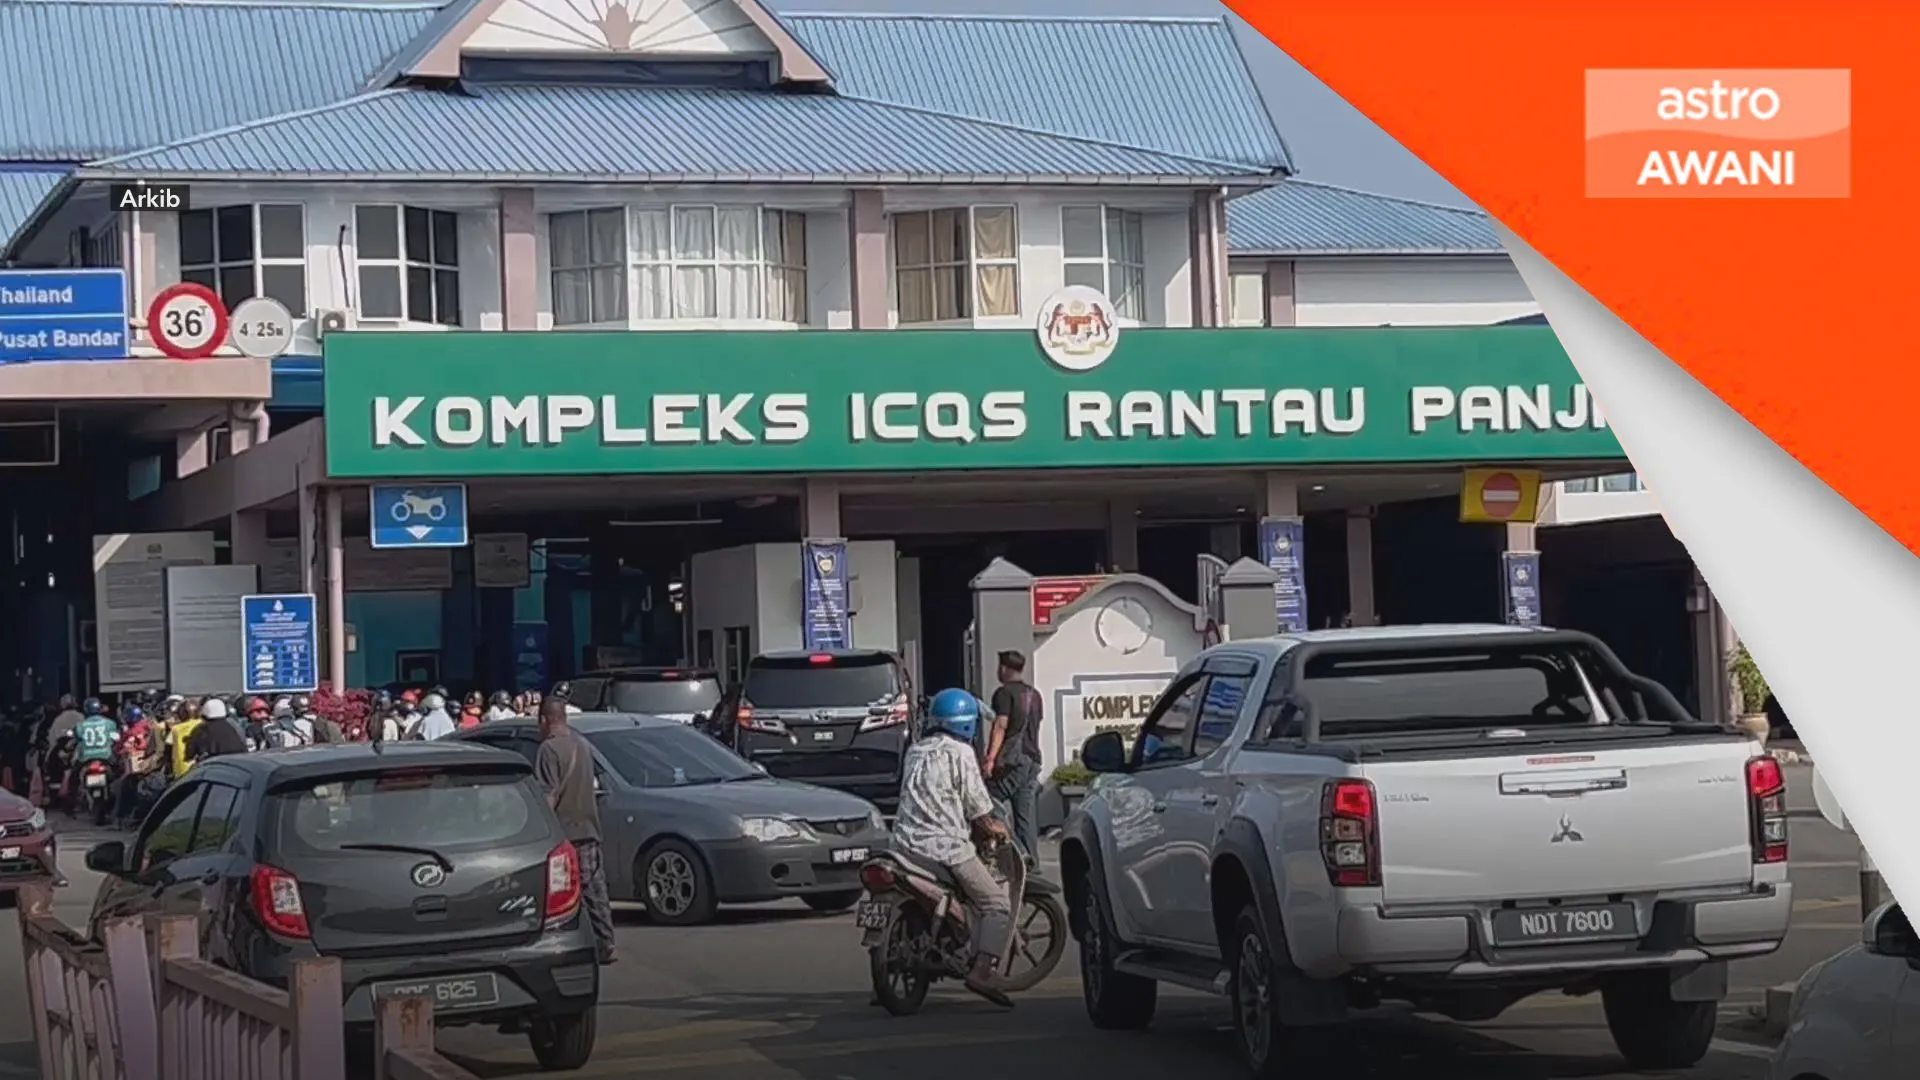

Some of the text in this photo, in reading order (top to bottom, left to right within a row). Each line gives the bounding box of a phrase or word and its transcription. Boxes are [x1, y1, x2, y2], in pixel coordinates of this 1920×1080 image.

[0, 285, 73, 304] hailand
[53, 329, 122, 347] Bandar
[372, 392, 809, 446] KOMPLEKS
[849, 389, 1027, 443] ICQS
[1066, 386, 1365, 438] RANTAU
[1082, 694, 1161, 720] KOMPLE
[84, 726, 107, 747] 03
[1519, 909, 1614, 936] NDT 7600
[435, 980, 478, 1000] 6125
